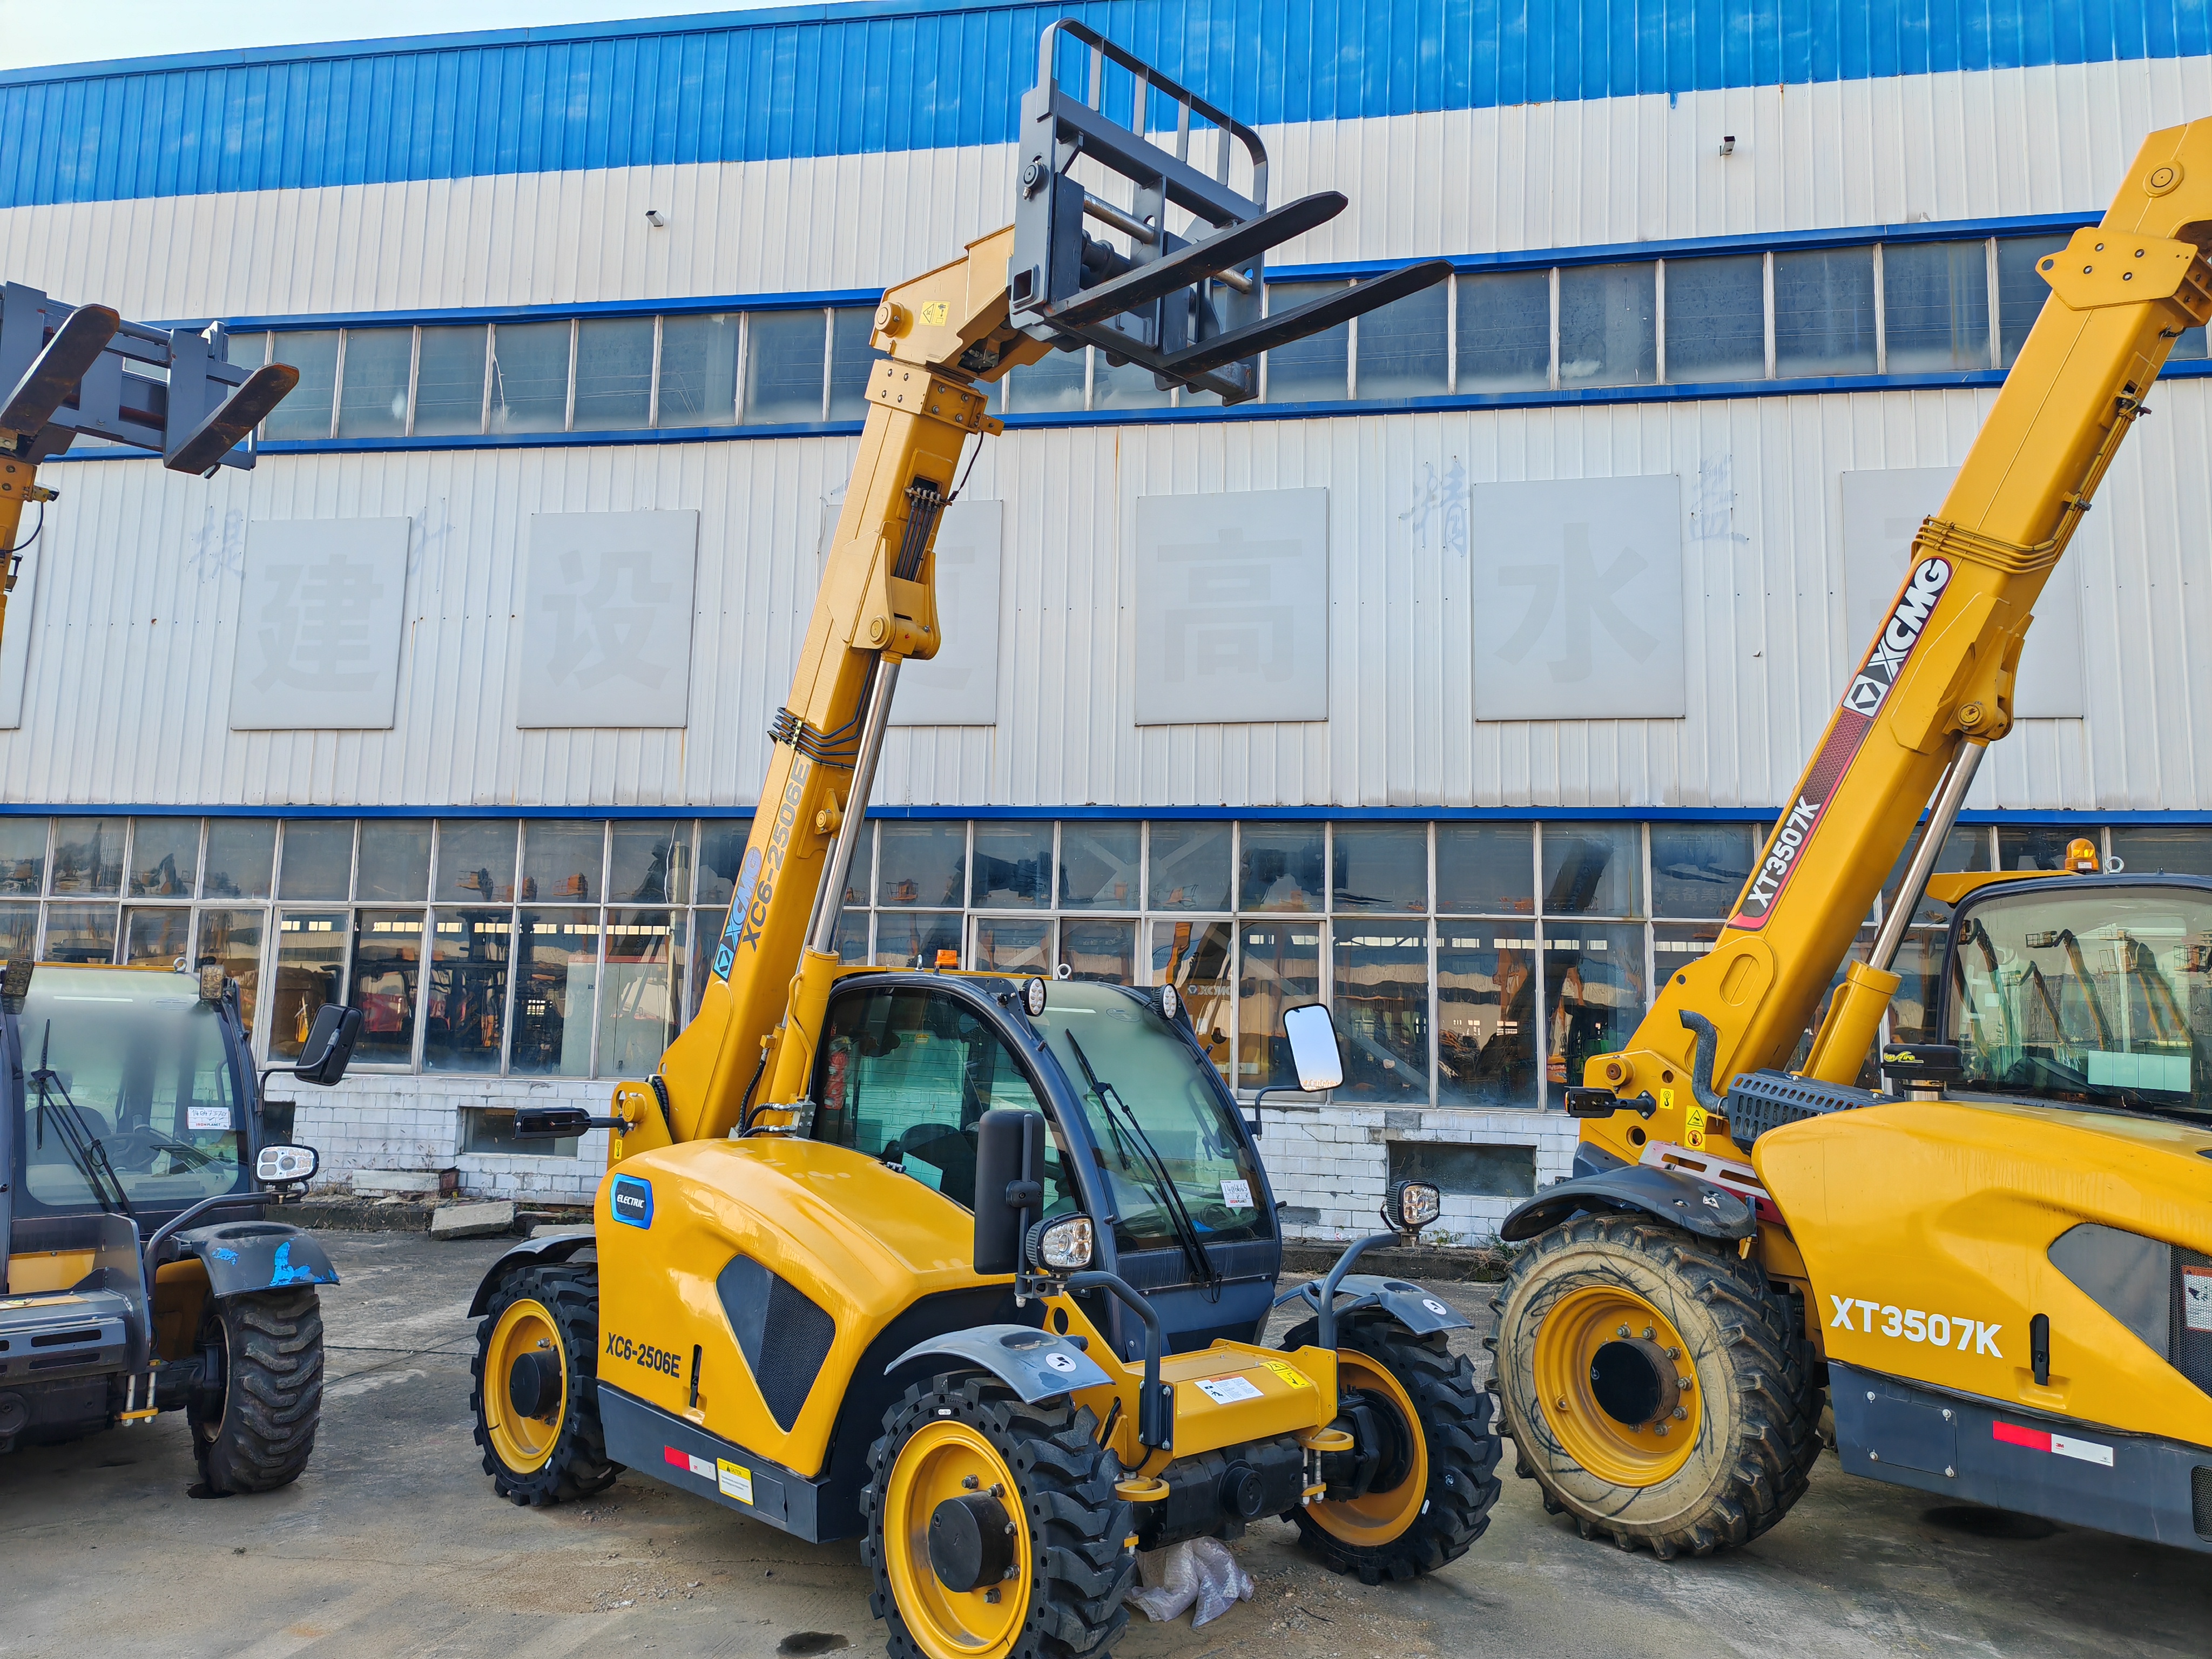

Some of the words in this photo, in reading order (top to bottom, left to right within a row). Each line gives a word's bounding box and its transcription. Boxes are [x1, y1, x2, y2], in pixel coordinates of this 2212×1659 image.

[251, 554, 384, 694] 建
[542, 549, 672, 692] 设
[1158, 528, 1303, 684] 高
[1493, 522, 1661, 683] 水
[1867, 559, 1948, 682] XCMG
[724, 846, 761, 948] XCMG
[742, 757, 810, 952] XC6-2506E
[1748, 795, 1821, 909] XT3507K
[617, 1194, 645, 1209] ELECTRIC
[605, 1332, 681, 1378] XC6-2506E
[1829, 1294, 2003, 1358] XT3507K
